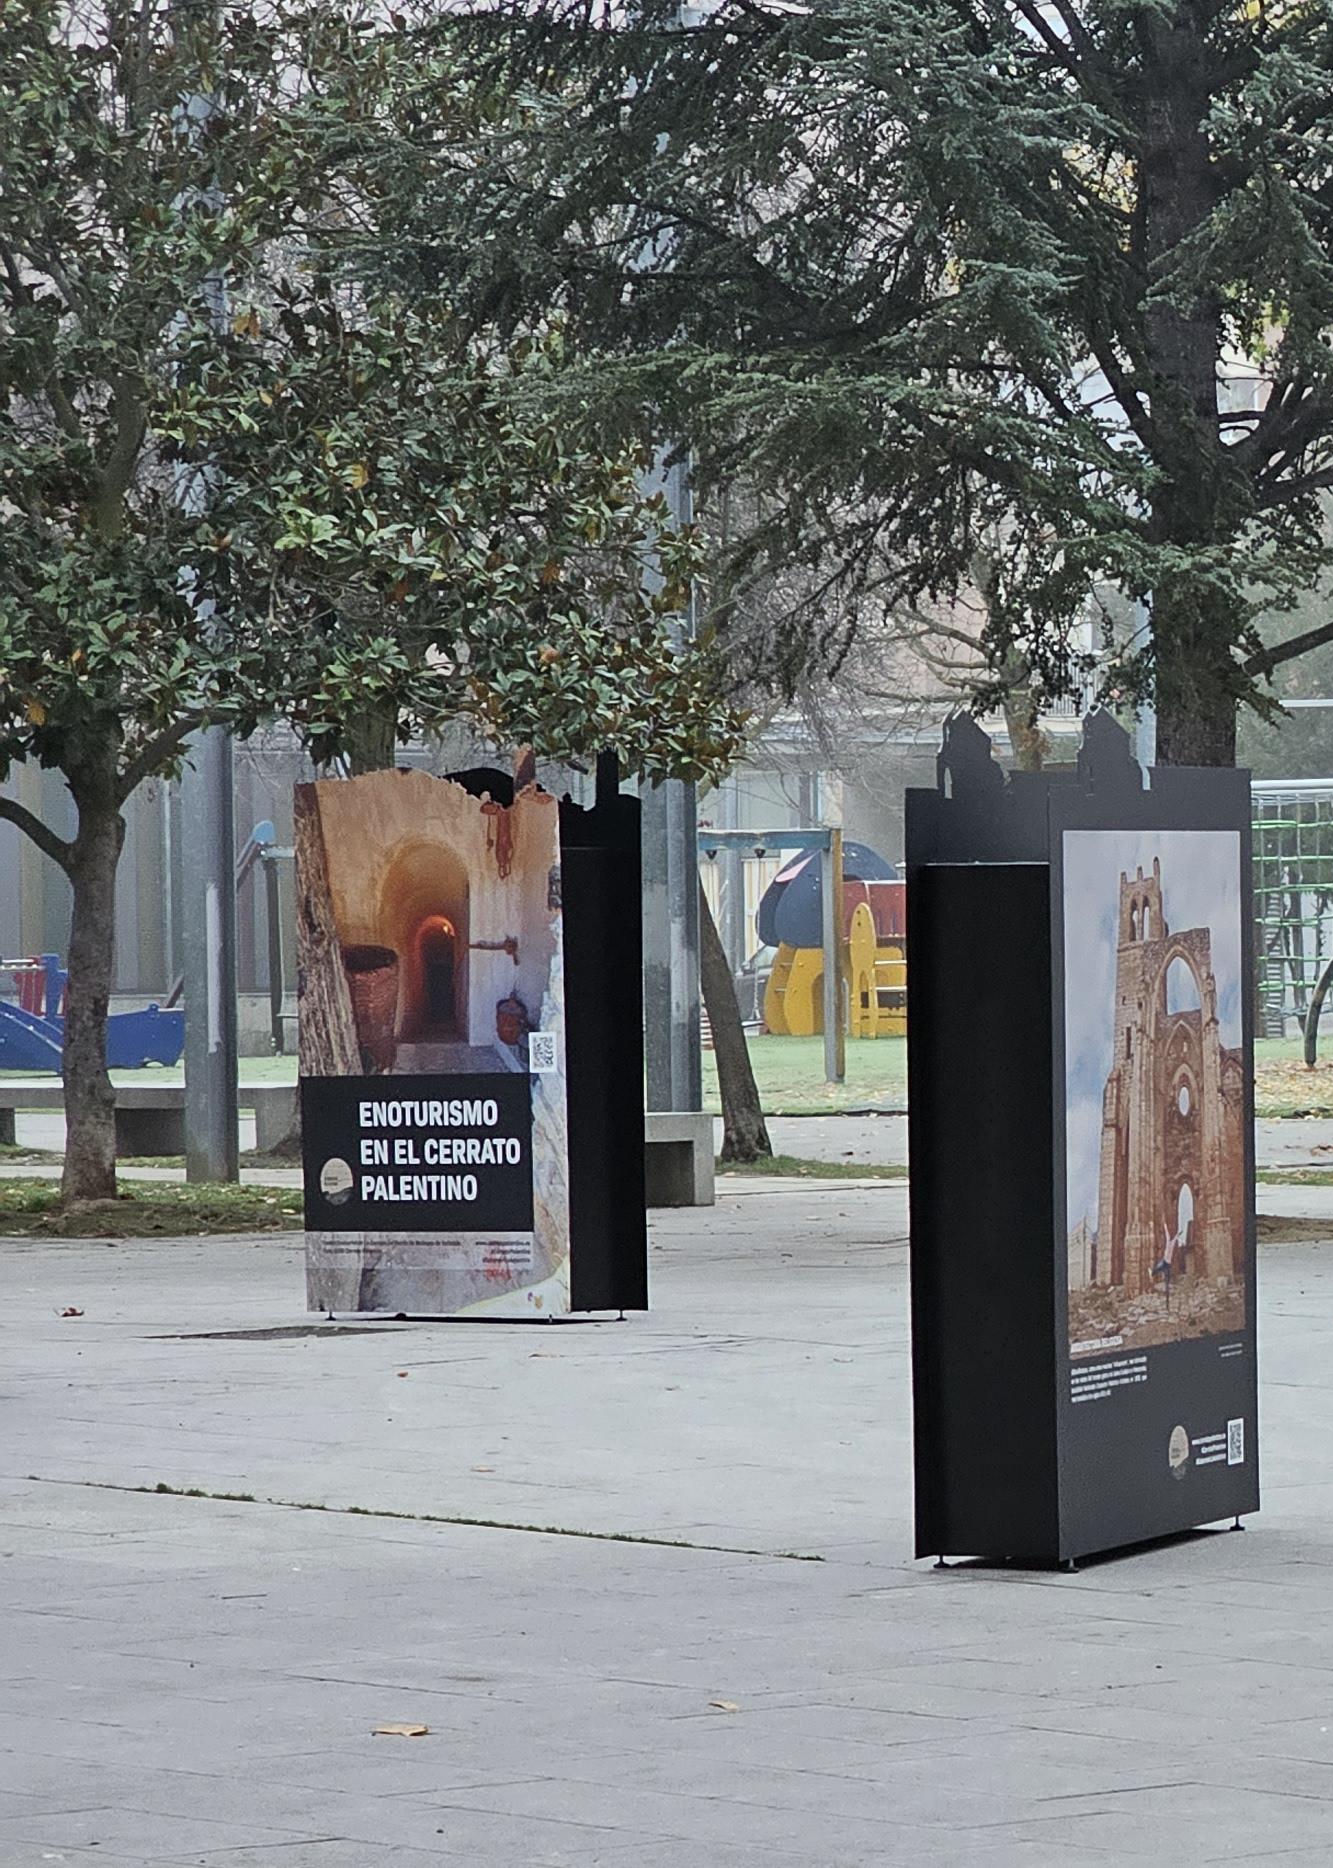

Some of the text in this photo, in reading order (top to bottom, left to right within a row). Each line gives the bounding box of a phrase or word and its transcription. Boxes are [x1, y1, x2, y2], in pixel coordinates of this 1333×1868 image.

[359, 1100, 498, 1127] ENOTURISMO
[360, 1138, 521, 1165] EN EL CERRATO
[361, 1175, 478, 1201] PALENTINO
